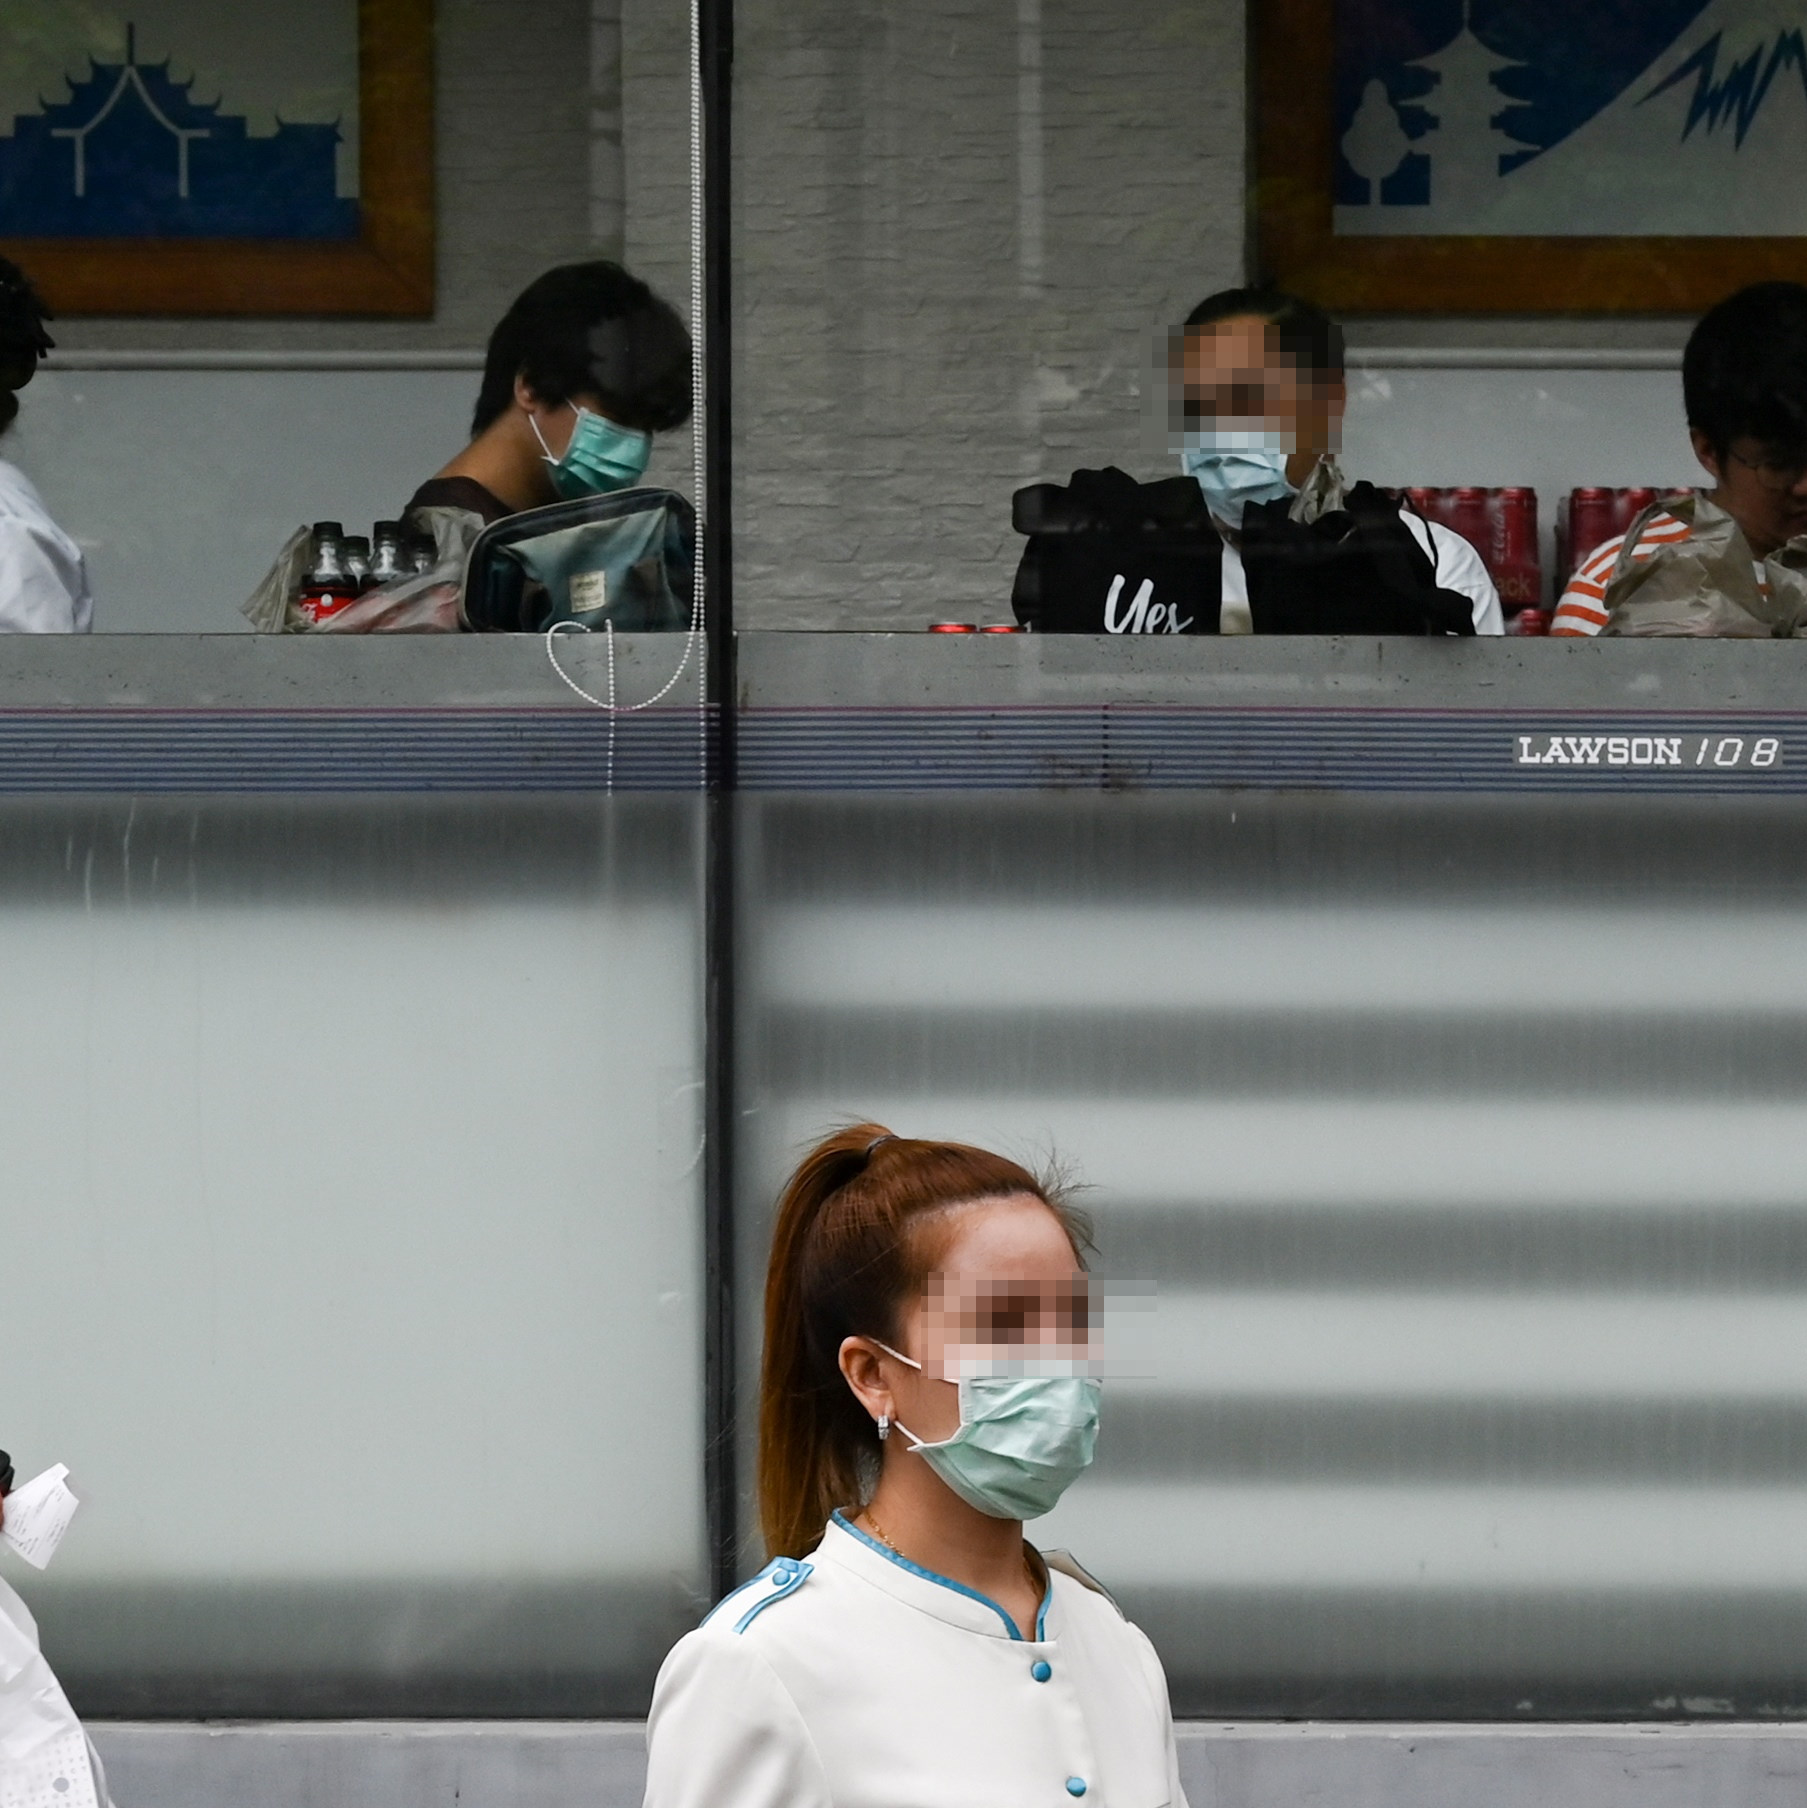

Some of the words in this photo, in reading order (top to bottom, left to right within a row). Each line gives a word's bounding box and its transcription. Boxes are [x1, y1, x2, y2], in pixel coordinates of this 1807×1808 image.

[1495, 572, 1531, 597] ack
[1104, 574, 1194, 634] Yes
[1518, 736, 1683, 765] LAWSON
[1695, 737, 1780, 767] 108
